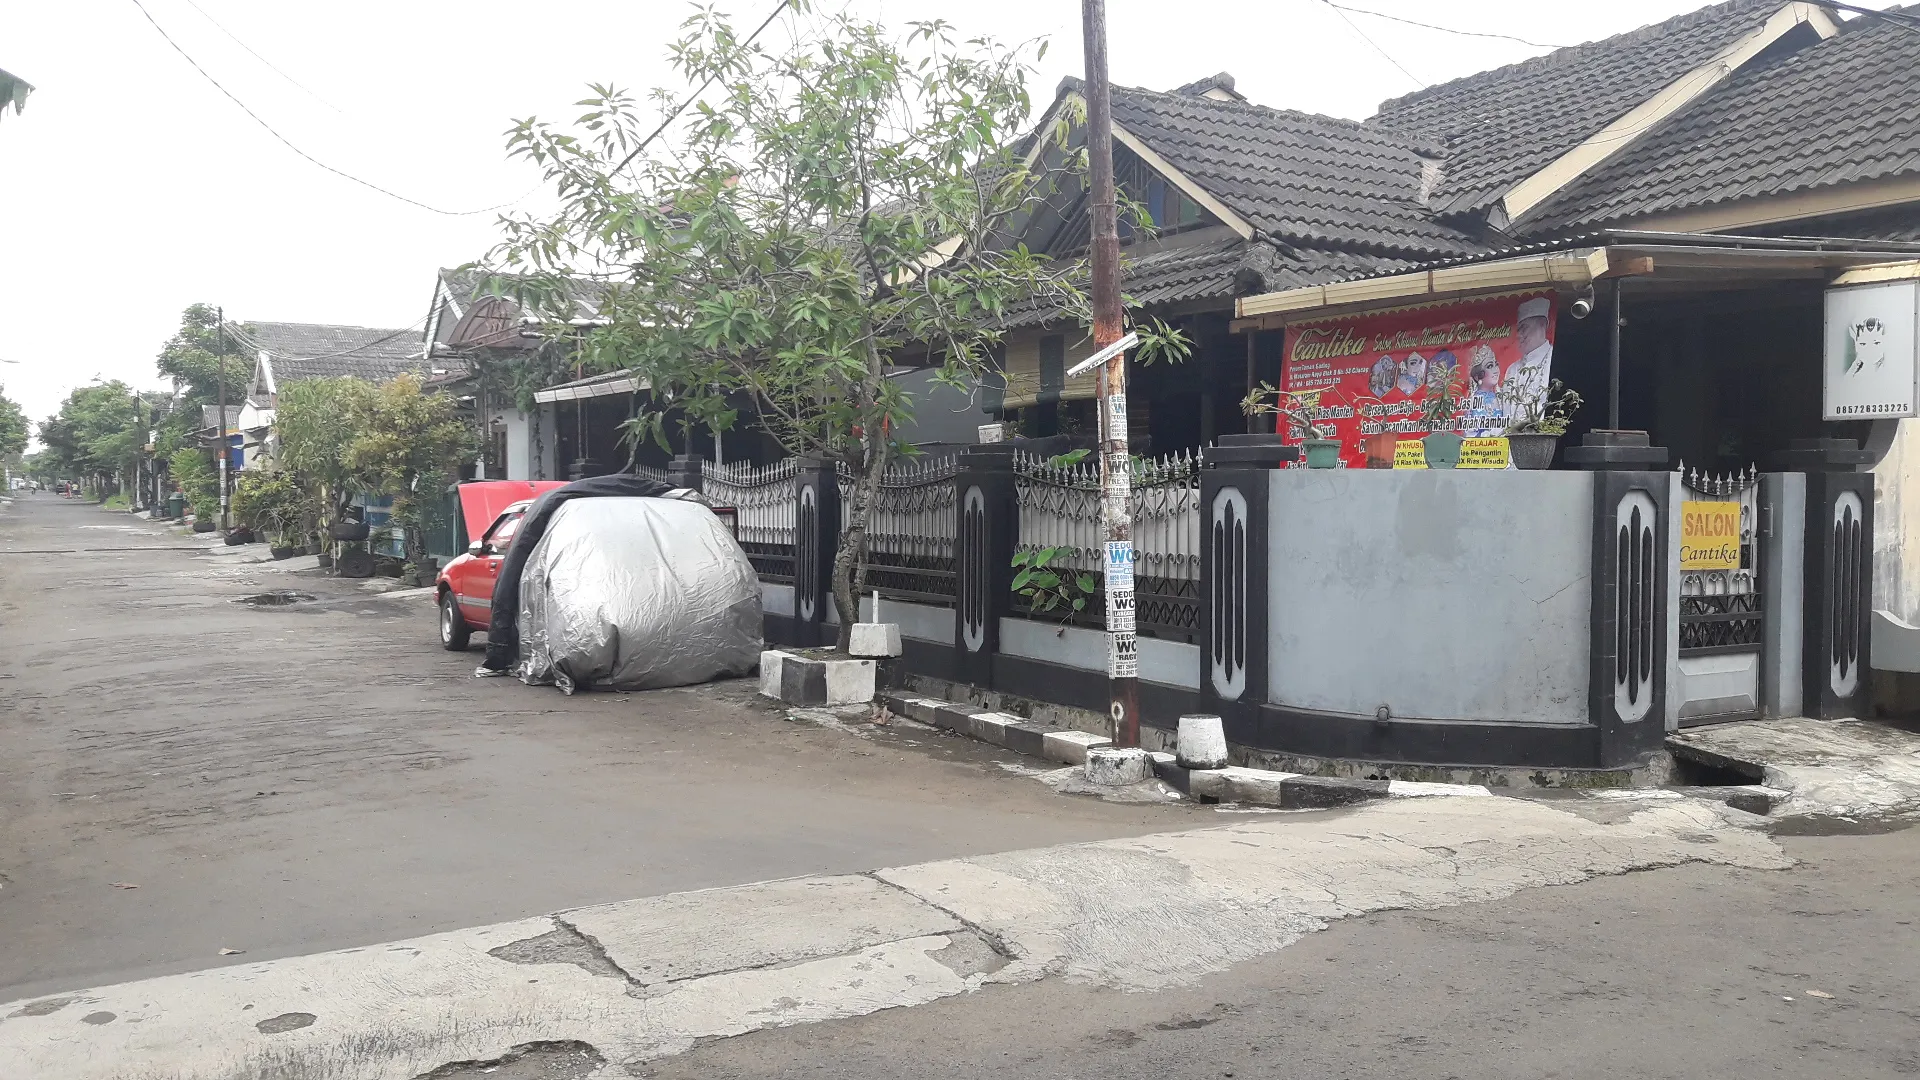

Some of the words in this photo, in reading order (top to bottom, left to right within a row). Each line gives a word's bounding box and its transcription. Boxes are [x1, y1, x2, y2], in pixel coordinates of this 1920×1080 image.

[1291, 326, 1367, 362] Cantika
[1317, 406, 1330, 419] Rias
[1331, 405, 1353, 418] Manten
[1836, 403, 1908, 414] 085726333225
[1465, 439, 1498, 447] PELAJAR
[1108, 460, 1129, 473] WC
[1685, 513, 1734, 537] SALON
[1109, 549, 1133, 563] WC
[1680, 543, 1738, 563] Cantika
[1115, 598, 1135, 609] WC
[1115, 633, 1136, 641] SEDO
[1116, 640, 1136, 653] WC
